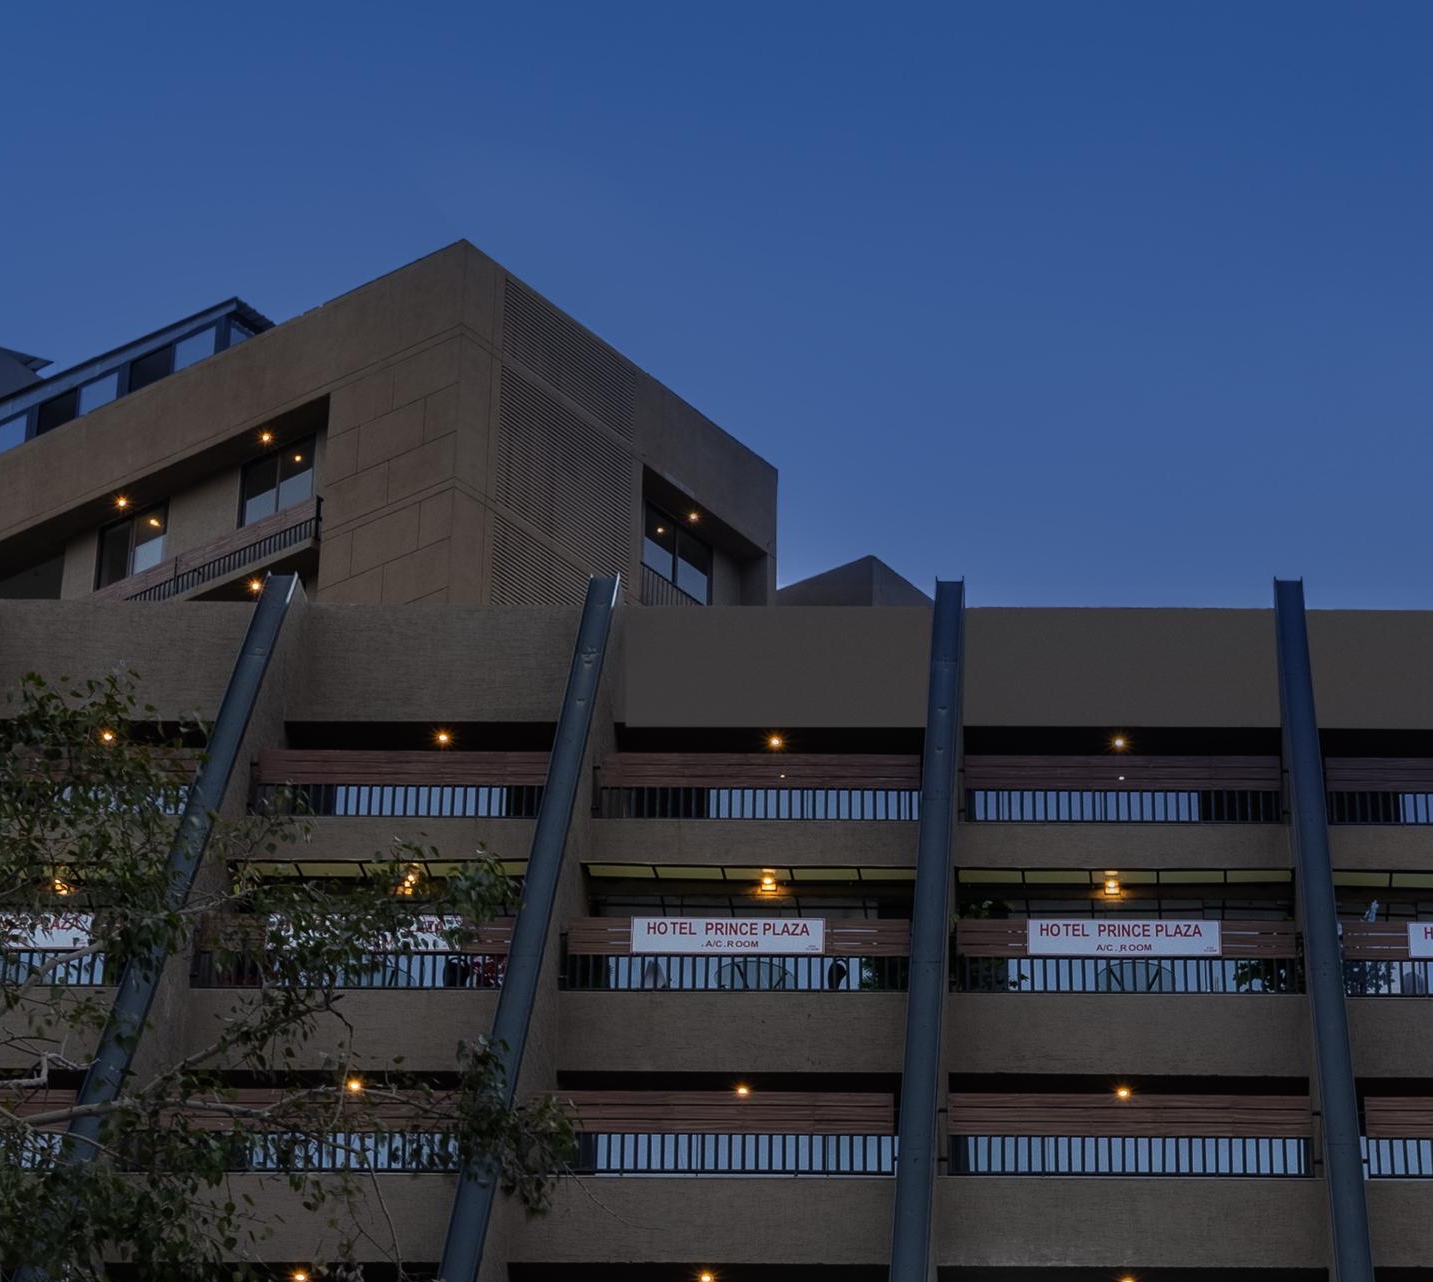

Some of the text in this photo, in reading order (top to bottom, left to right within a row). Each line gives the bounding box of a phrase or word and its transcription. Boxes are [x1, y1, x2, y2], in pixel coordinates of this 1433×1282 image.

[646, 921, 810, 937] HOTEL PRINCE PLAZA
[1039, 923, 1203, 938] HOTEL PRINCE PLAZA
